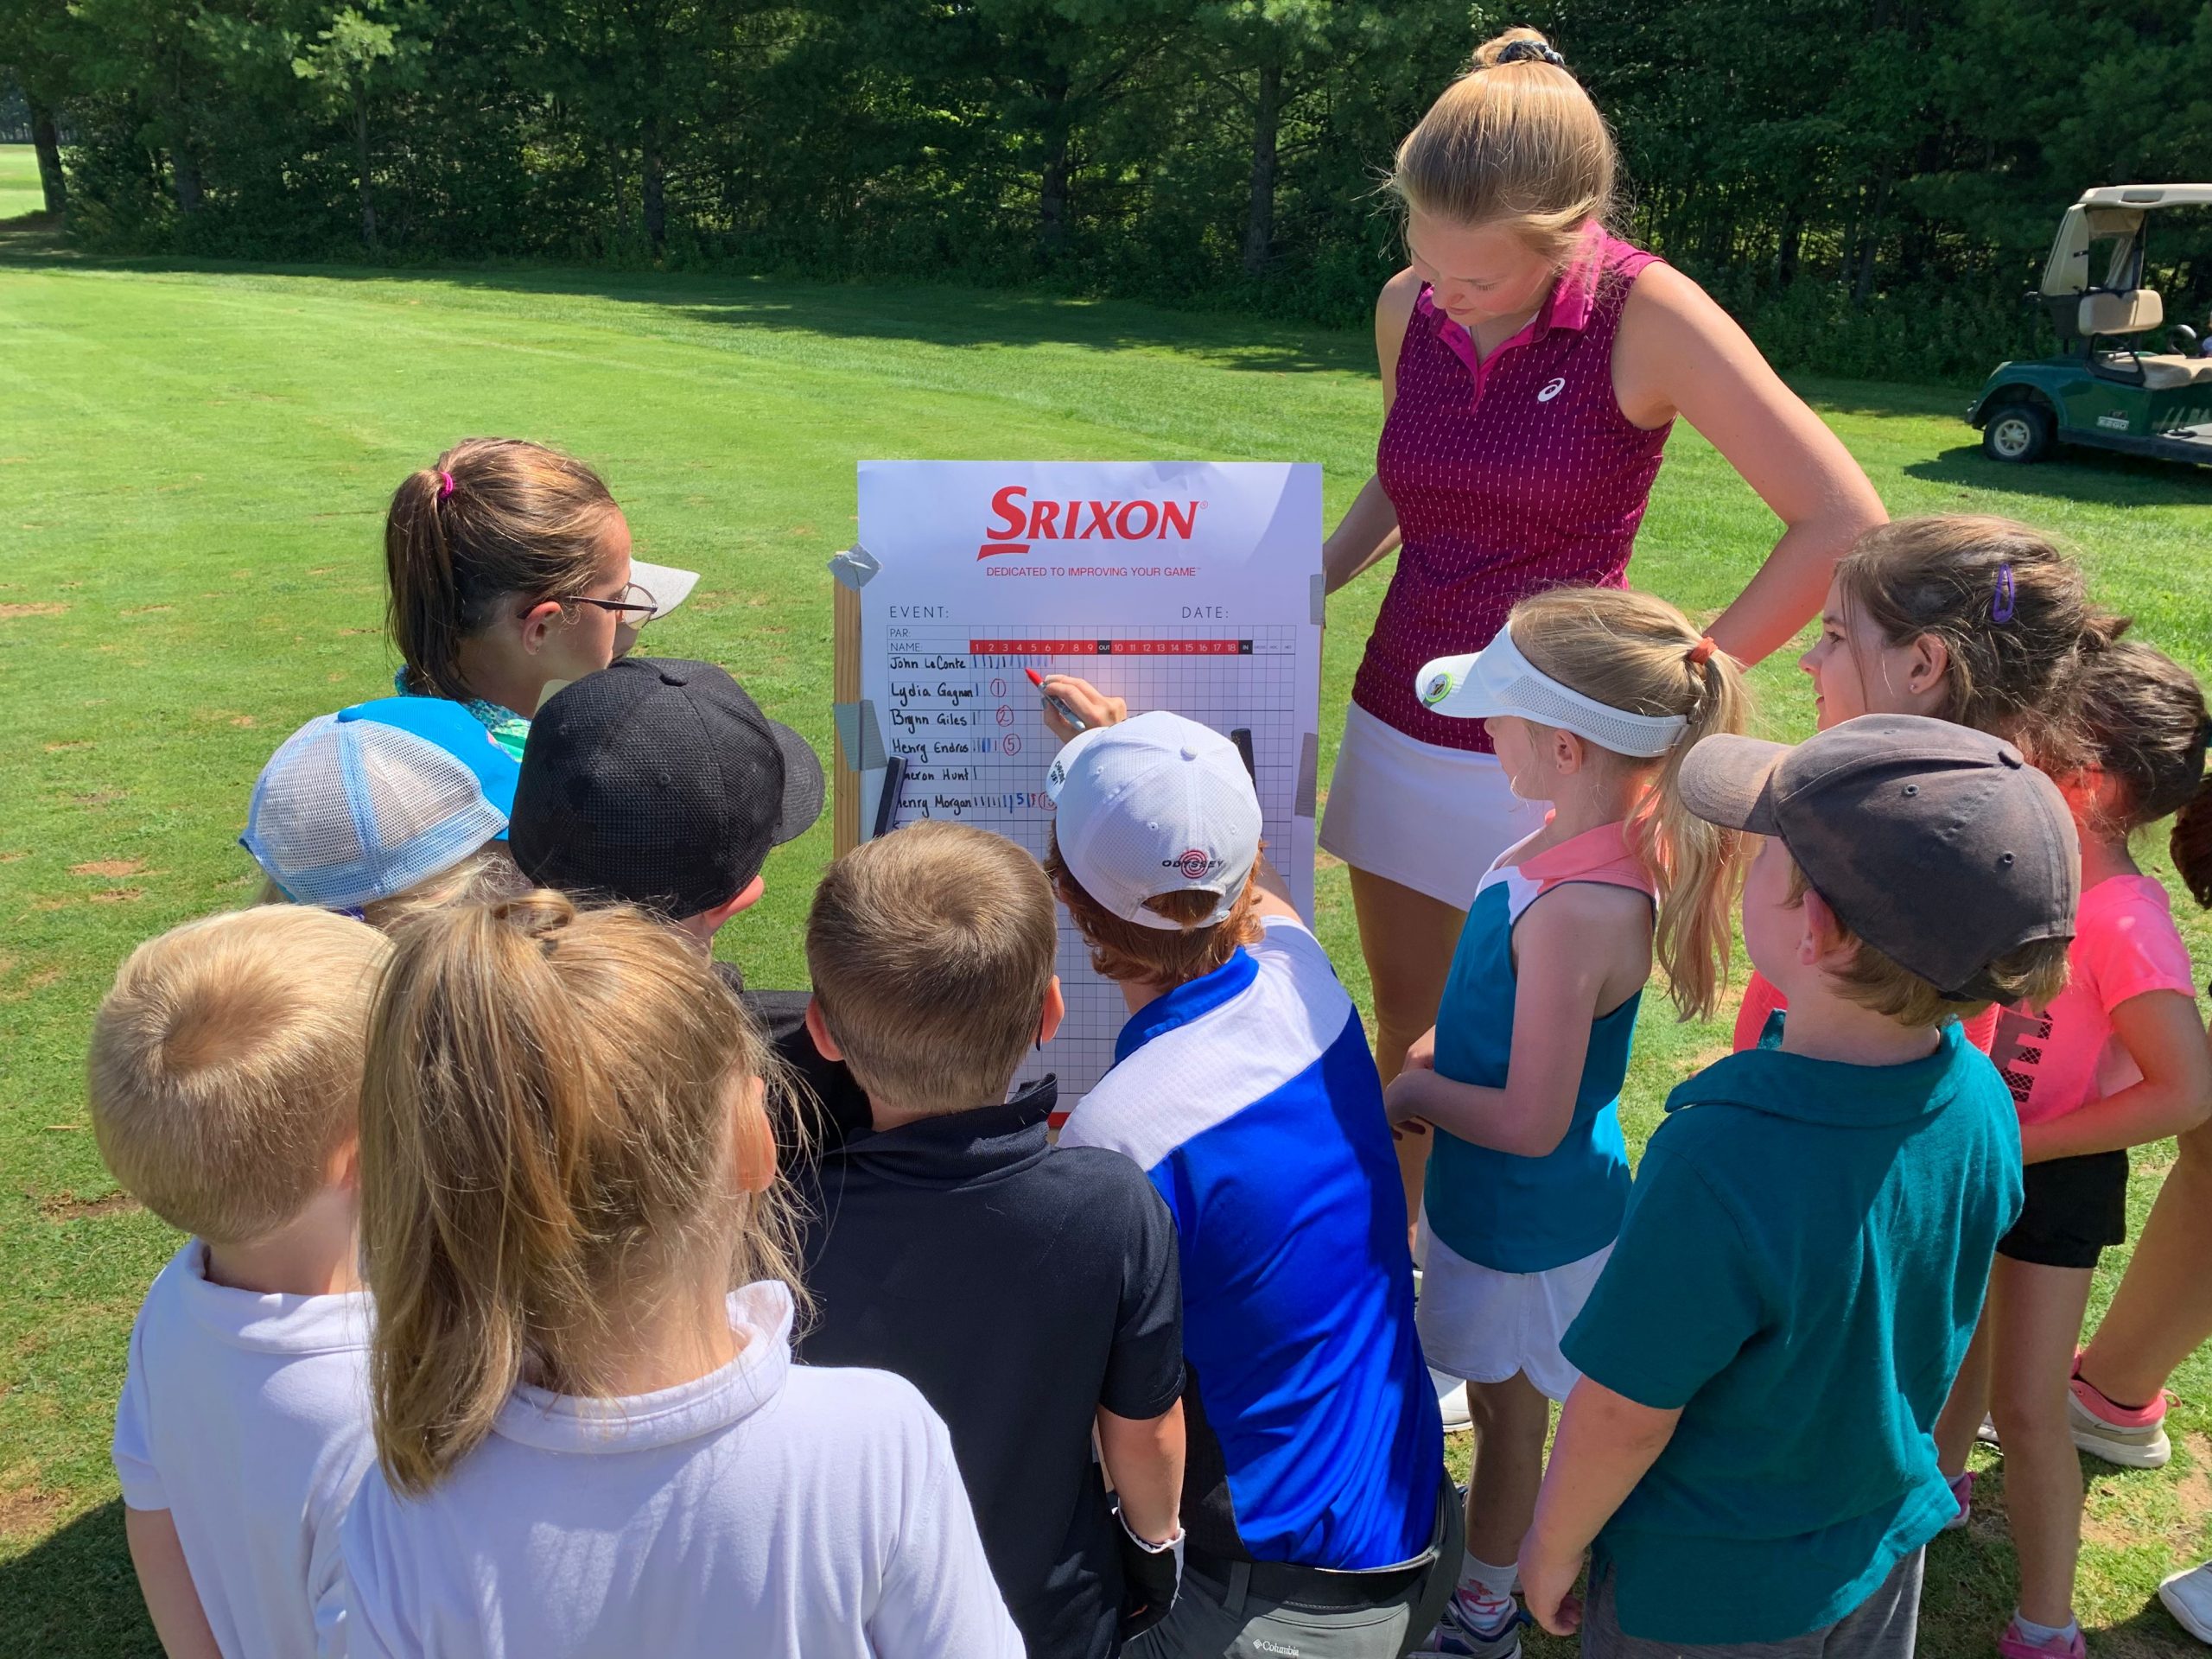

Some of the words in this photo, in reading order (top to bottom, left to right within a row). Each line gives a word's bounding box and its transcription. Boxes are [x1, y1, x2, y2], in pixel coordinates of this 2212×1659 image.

[987, 486, 1200, 540] SRIXON
[987, 567, 1046, 577] DEDICATED
[1052, 567, 1065, 577] TO
[1068, 567, 1127, 577] IMPROVING
[1130, 567, 1160, 577] YOUR
[890, 606, 949, 618] EVENT:
[1182, 607, 1229, 619] DATE:
[890, 629, 911, 638] PAR:
[890, 643, 923, 652] NAME:
[890, 657, 918, 670] John
[891, 683, 931, 707] Lydia
[938, 715, 967, 726] Giles
[893, 738, 928, 763] Henry
[943, 768, 969, 780] Hunt
[899, 798, 930, 818] enry
[935, 794, 972, 816] Morgan
[1162, 860, 1224, 868] ODYSSEY
[1262, 1641, 1300, 1656] Columbia
